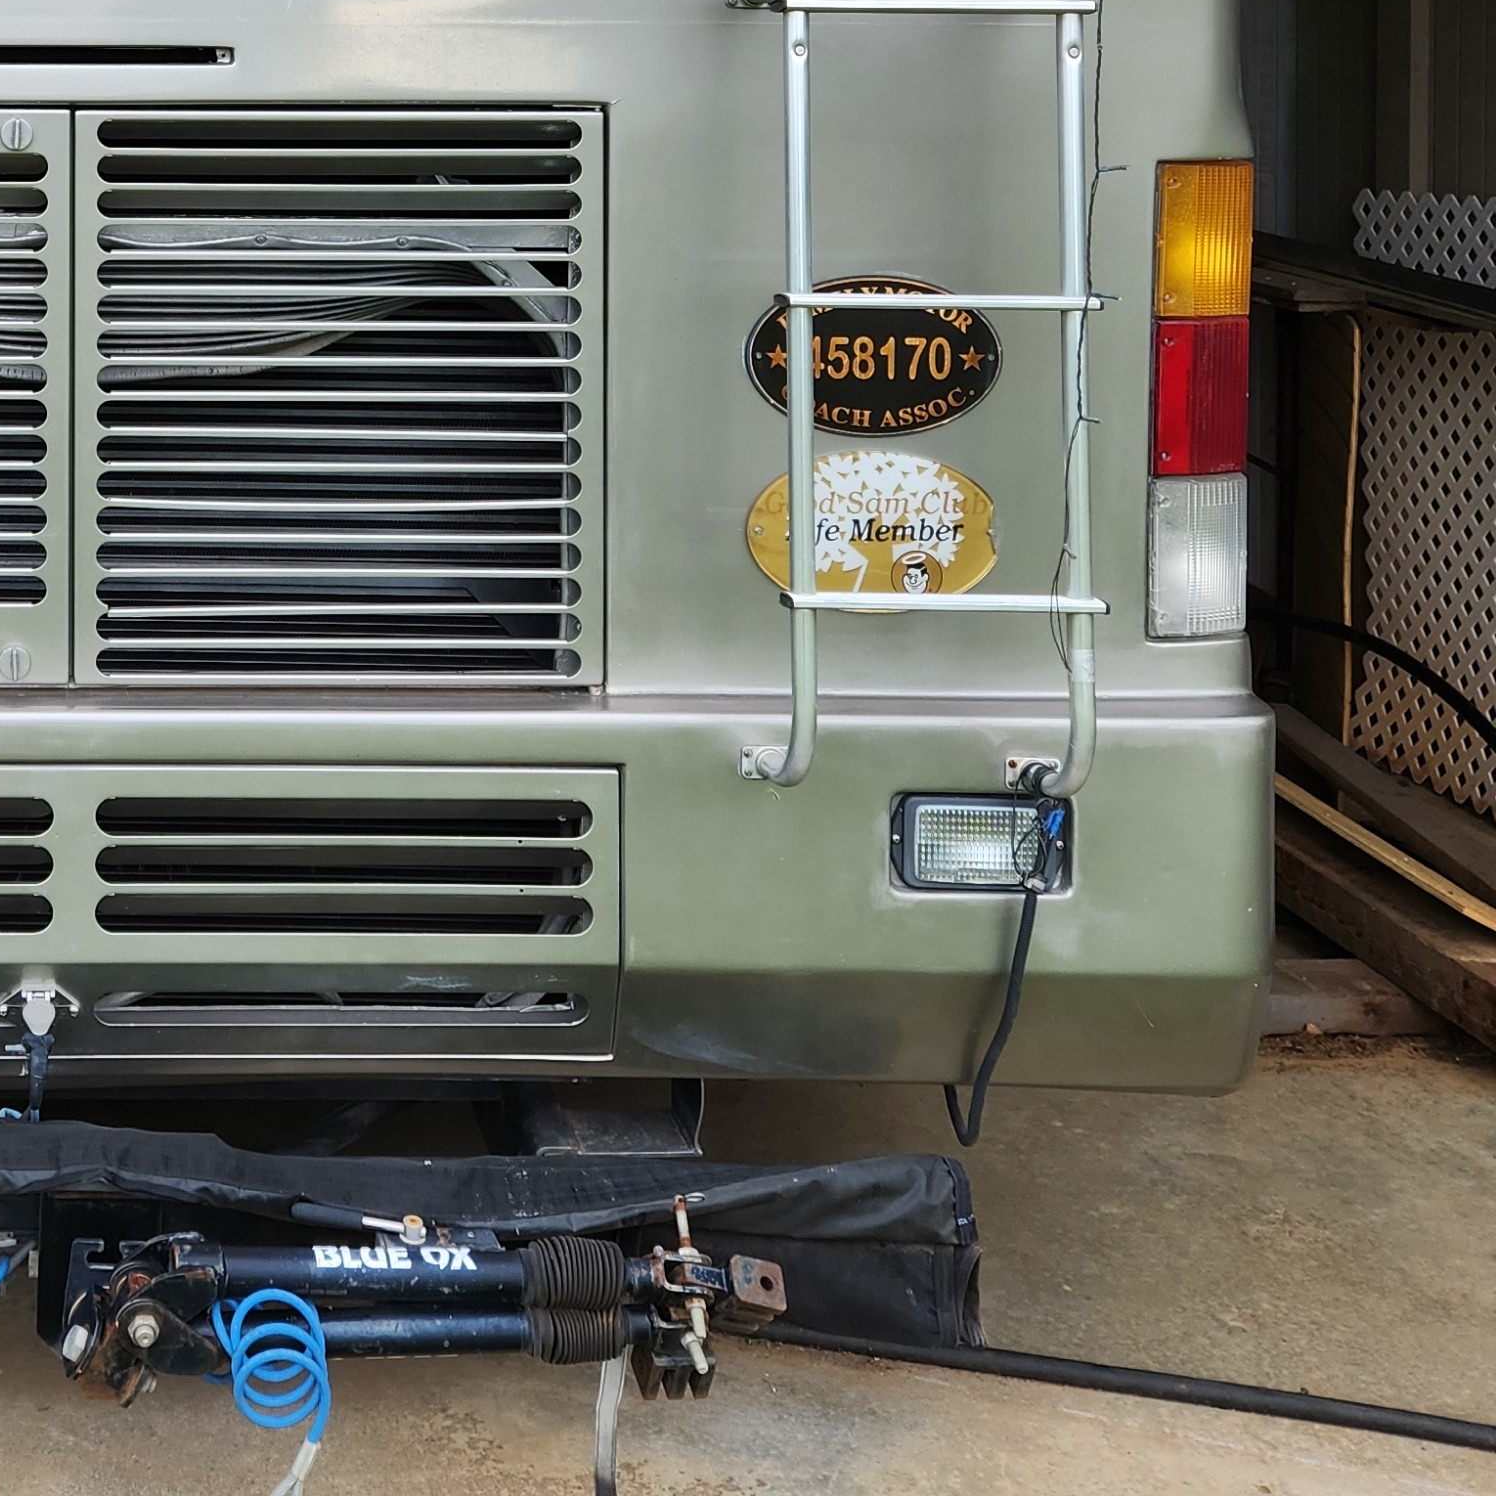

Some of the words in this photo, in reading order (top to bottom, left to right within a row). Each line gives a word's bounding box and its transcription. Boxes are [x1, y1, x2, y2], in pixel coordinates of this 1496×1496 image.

[782, 385, 872, 426] ACH
[880, 387, 975, 428] ASSOC.
[765, 492, 836, 515] Gd
[846, 492, 909, 514] Sam
[921, 491, 988, 515] Club
[850, 518, 964, 542] Member
[312, 1245, 413, 1269] BLUE
